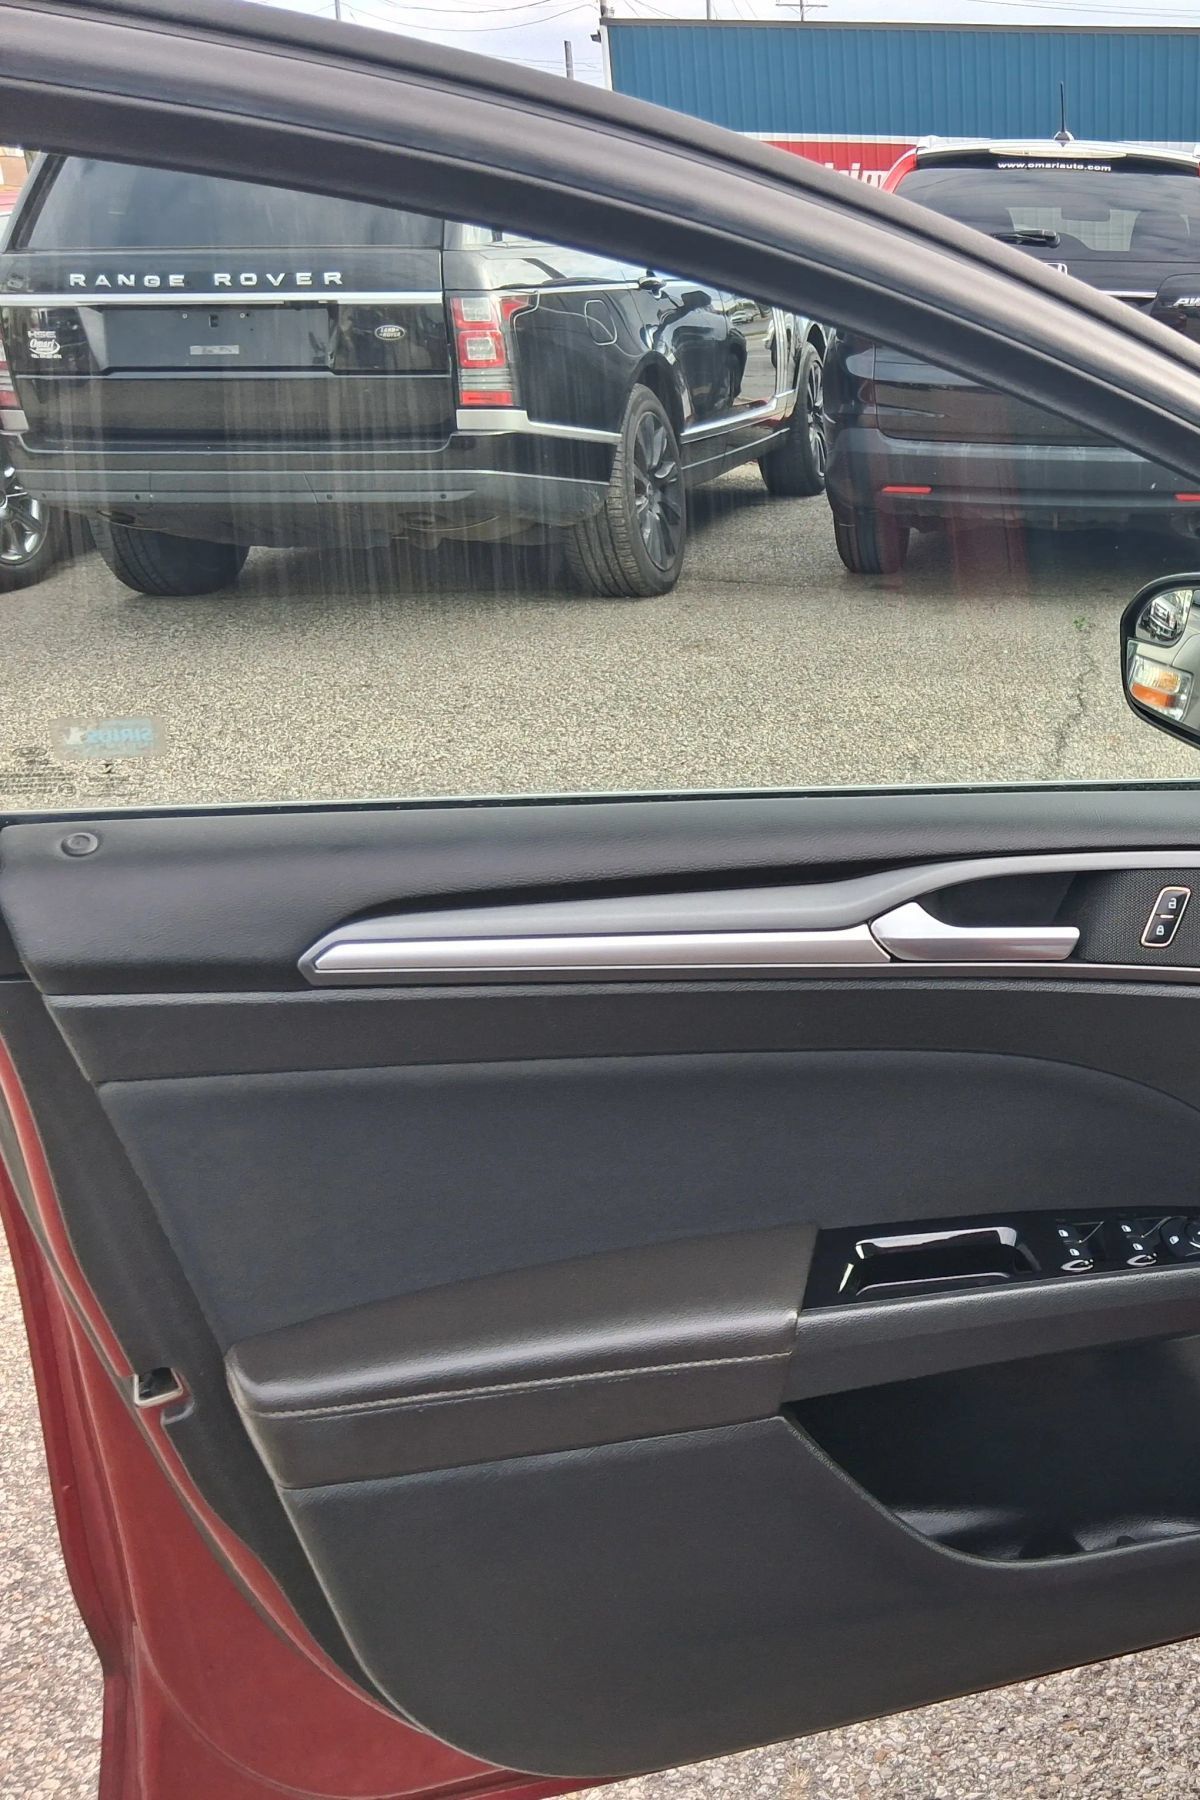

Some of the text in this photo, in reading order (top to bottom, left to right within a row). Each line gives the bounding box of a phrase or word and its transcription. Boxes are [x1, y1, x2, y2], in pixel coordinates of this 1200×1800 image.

[998, 162, 1111, 172] www.omariauto.com
[69, 271, 344, 288] RANGE ROVER
